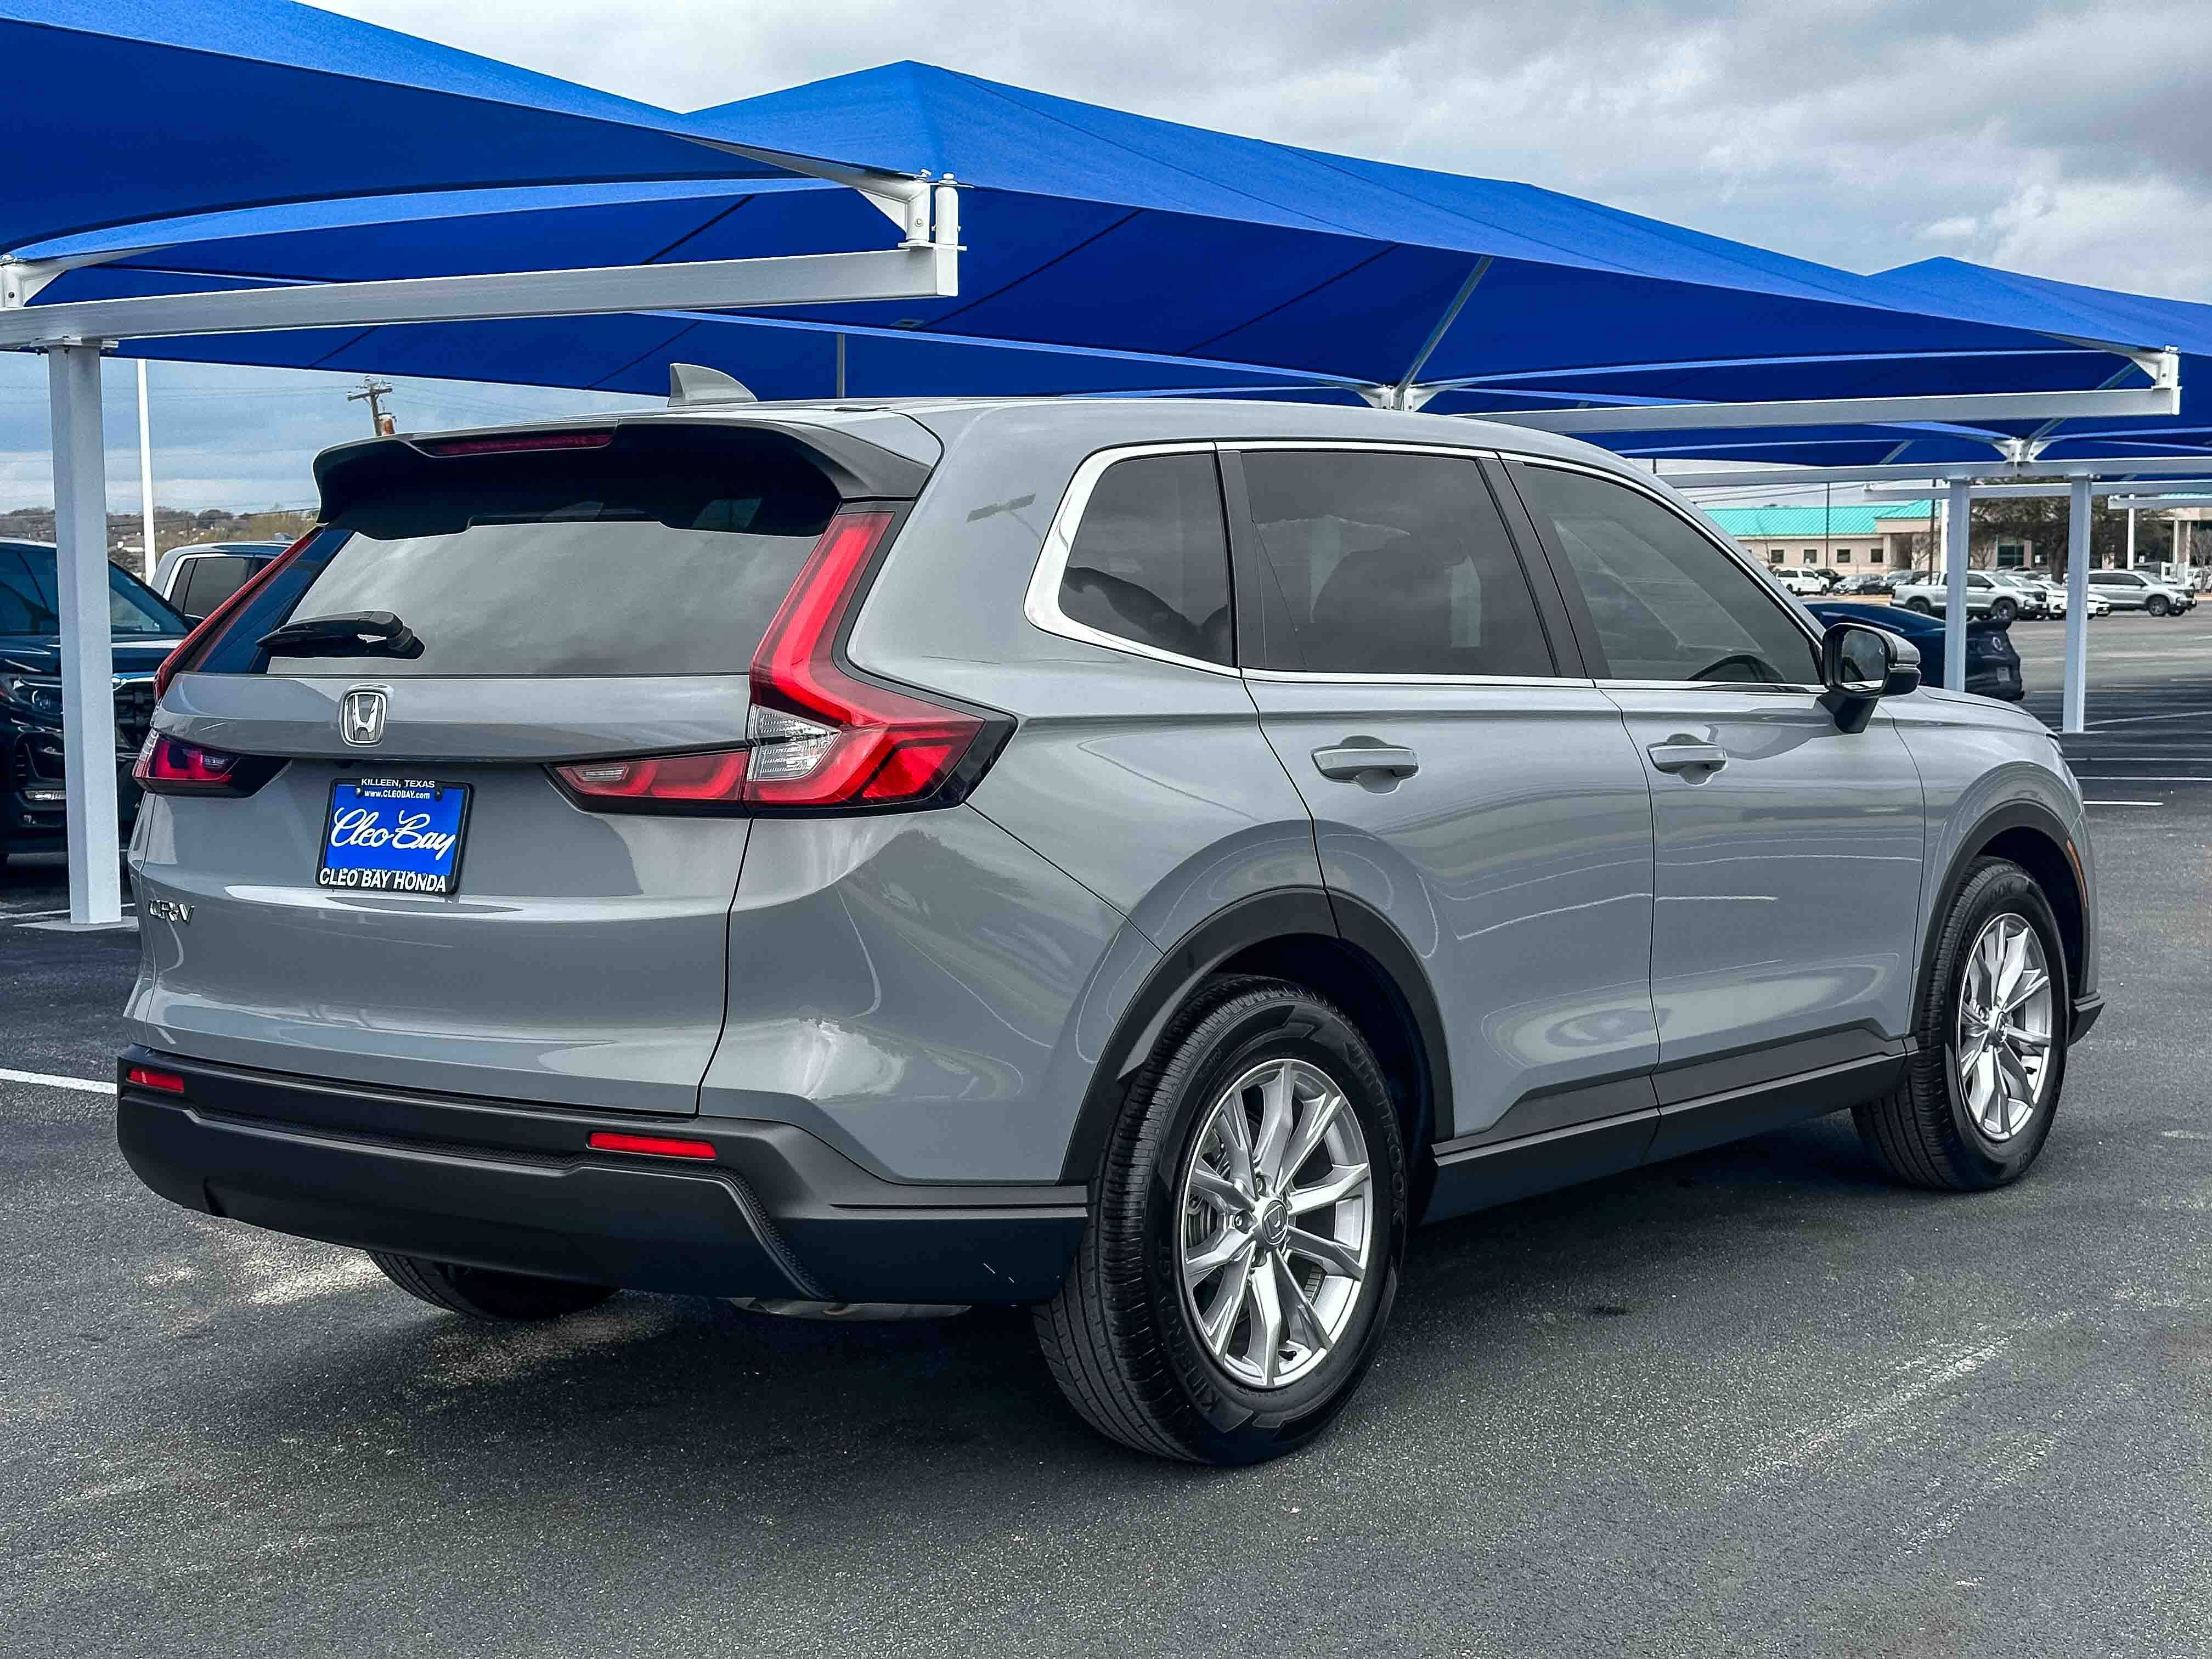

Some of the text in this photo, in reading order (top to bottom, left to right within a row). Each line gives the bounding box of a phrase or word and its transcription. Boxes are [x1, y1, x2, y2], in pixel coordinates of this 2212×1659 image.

[361, 778, 435, 788] KILLEEN, TEXAS
[364, 789, 430, 799] www.CLEOBAY.com
[330, 807, 456, 860] Cleo Bay
[319, 867, 358, 887] CLEO
[361, 870, 391, 888] BAY
[393, 871, 446, 892] HONDA
